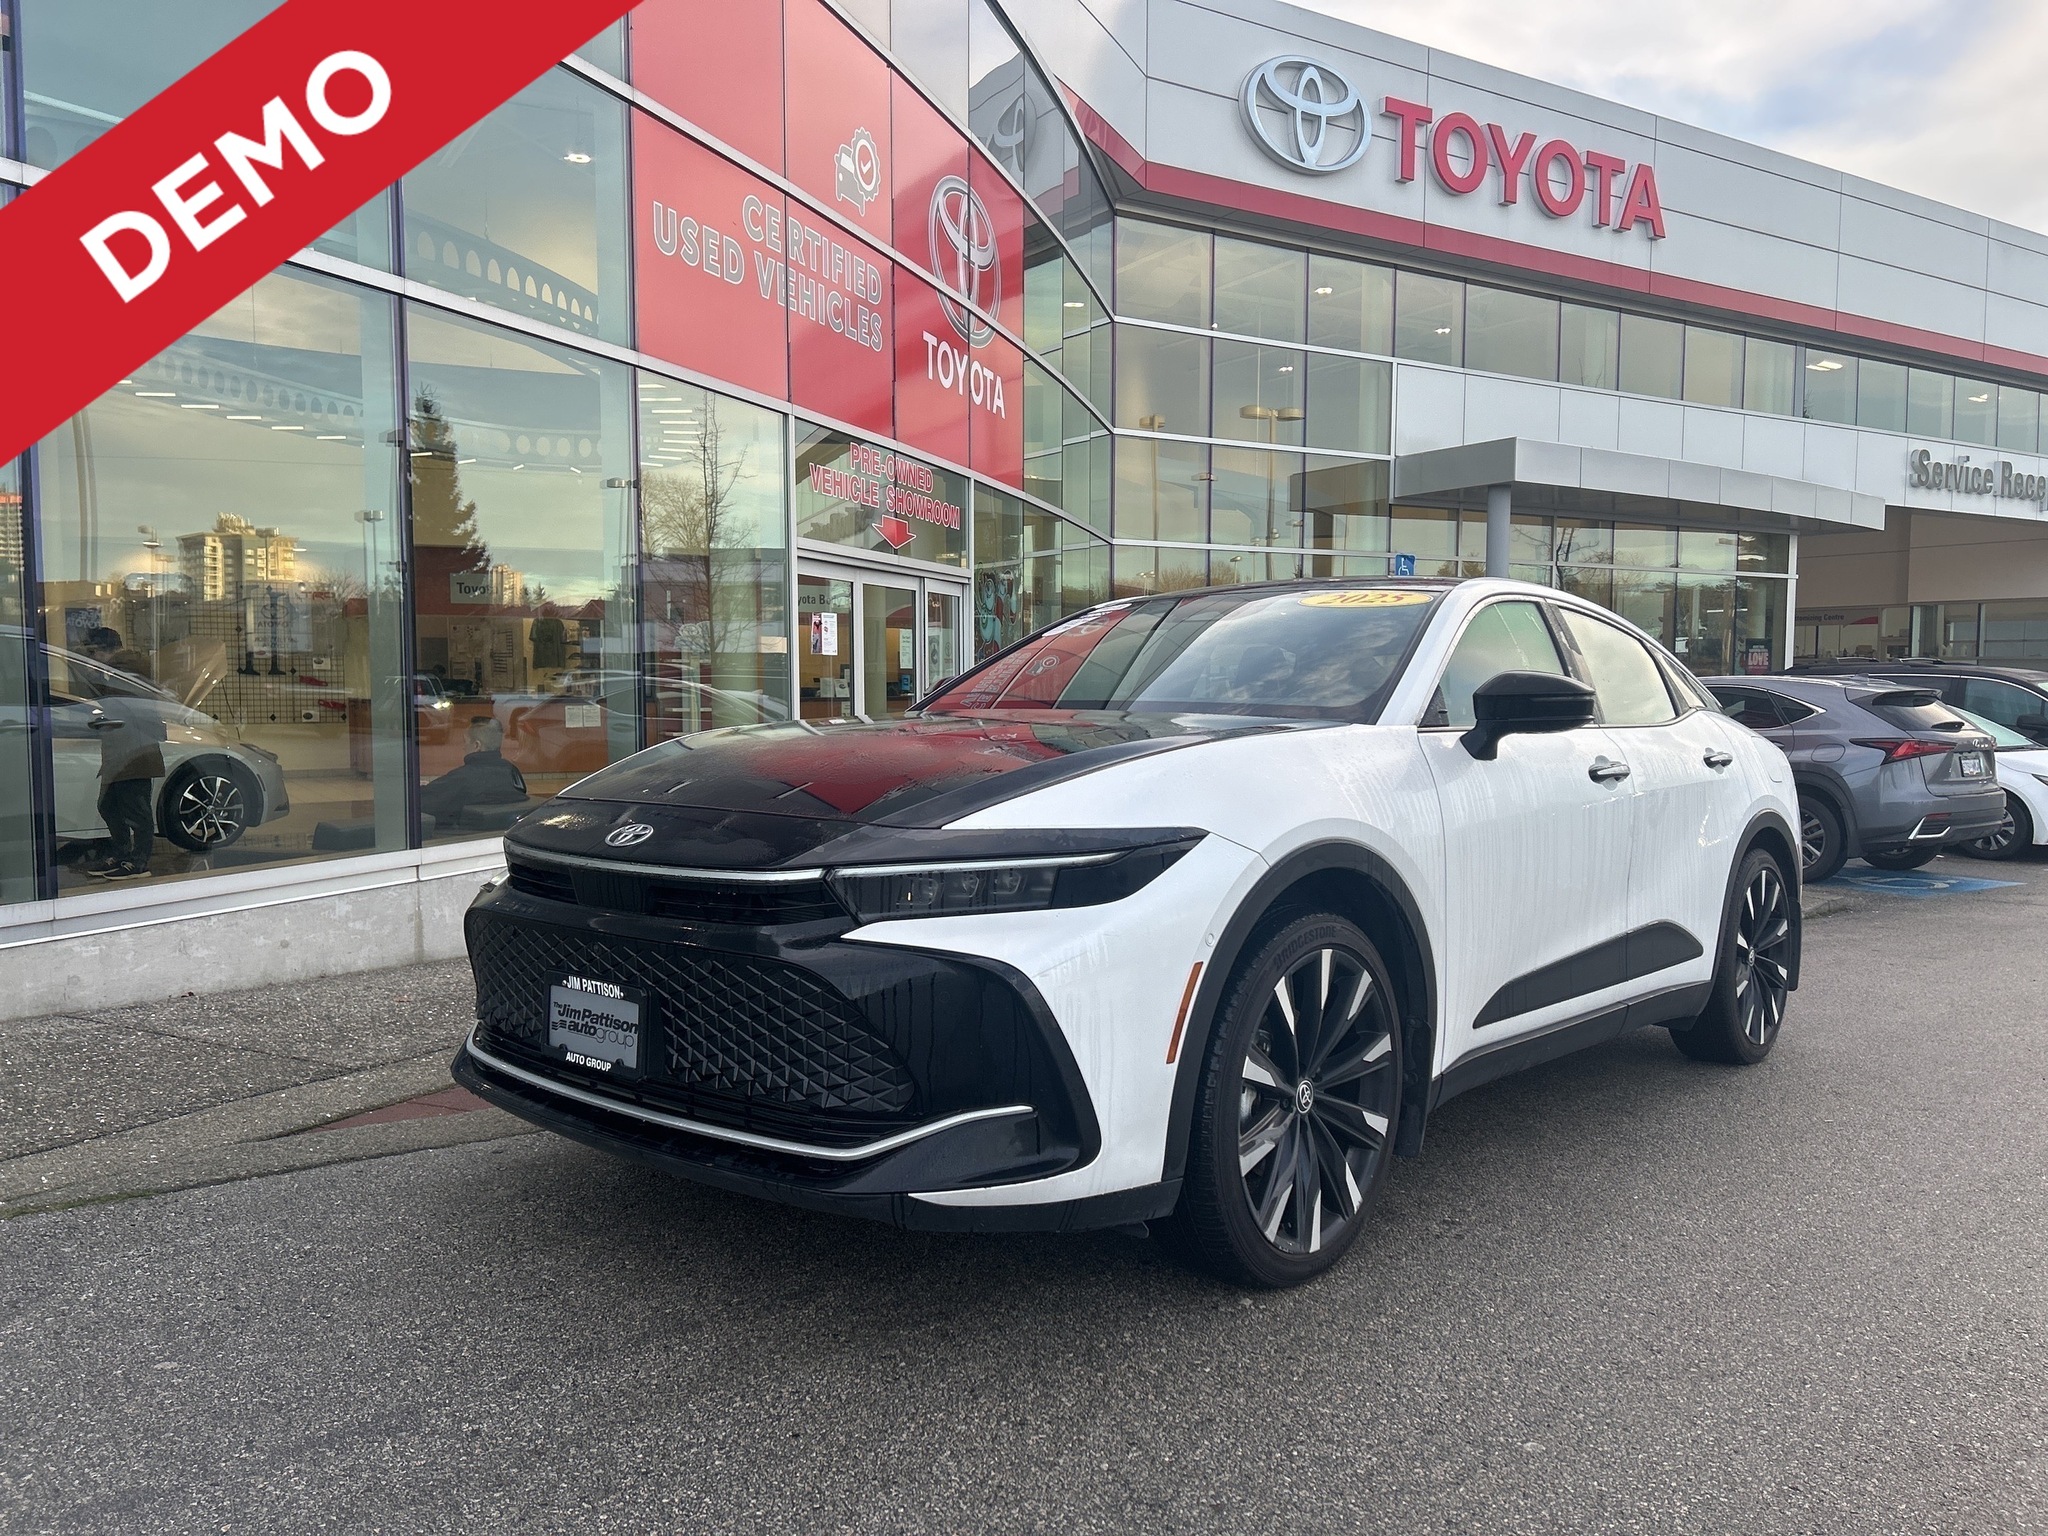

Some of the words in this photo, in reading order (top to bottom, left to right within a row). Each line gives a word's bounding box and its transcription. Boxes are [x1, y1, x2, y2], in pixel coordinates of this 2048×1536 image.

[1379, 95, 1666, 239] TOYOTA
[653, 200, 745, 285] USED
[753, 250, 883, 352] VEHICLES
[742, 194, 882, 305] CERTIFIED
[922, 330, 1006, 420] TOYOTA
[808, 462, 880, 508] VEHICLE
[885, 484, 961, 531] SHOWROOM
[850, 442, 934, 494] PRE-OWNED
[1909, 449, 1994, 495] Service
[1993, 460, 2048, 512] Rece
[456, 582, 499, 597] Toyo
[1316, 592, 1414, 605] 2025
[1748, 652, 1769, 666] LOVE
[567, 975, 581, 991] JIM
[581, 978, 621, 999] PATTISON
[565, 1051, 586, 1066] AUTO
[585, 1056, 612, 1072] GROUP
